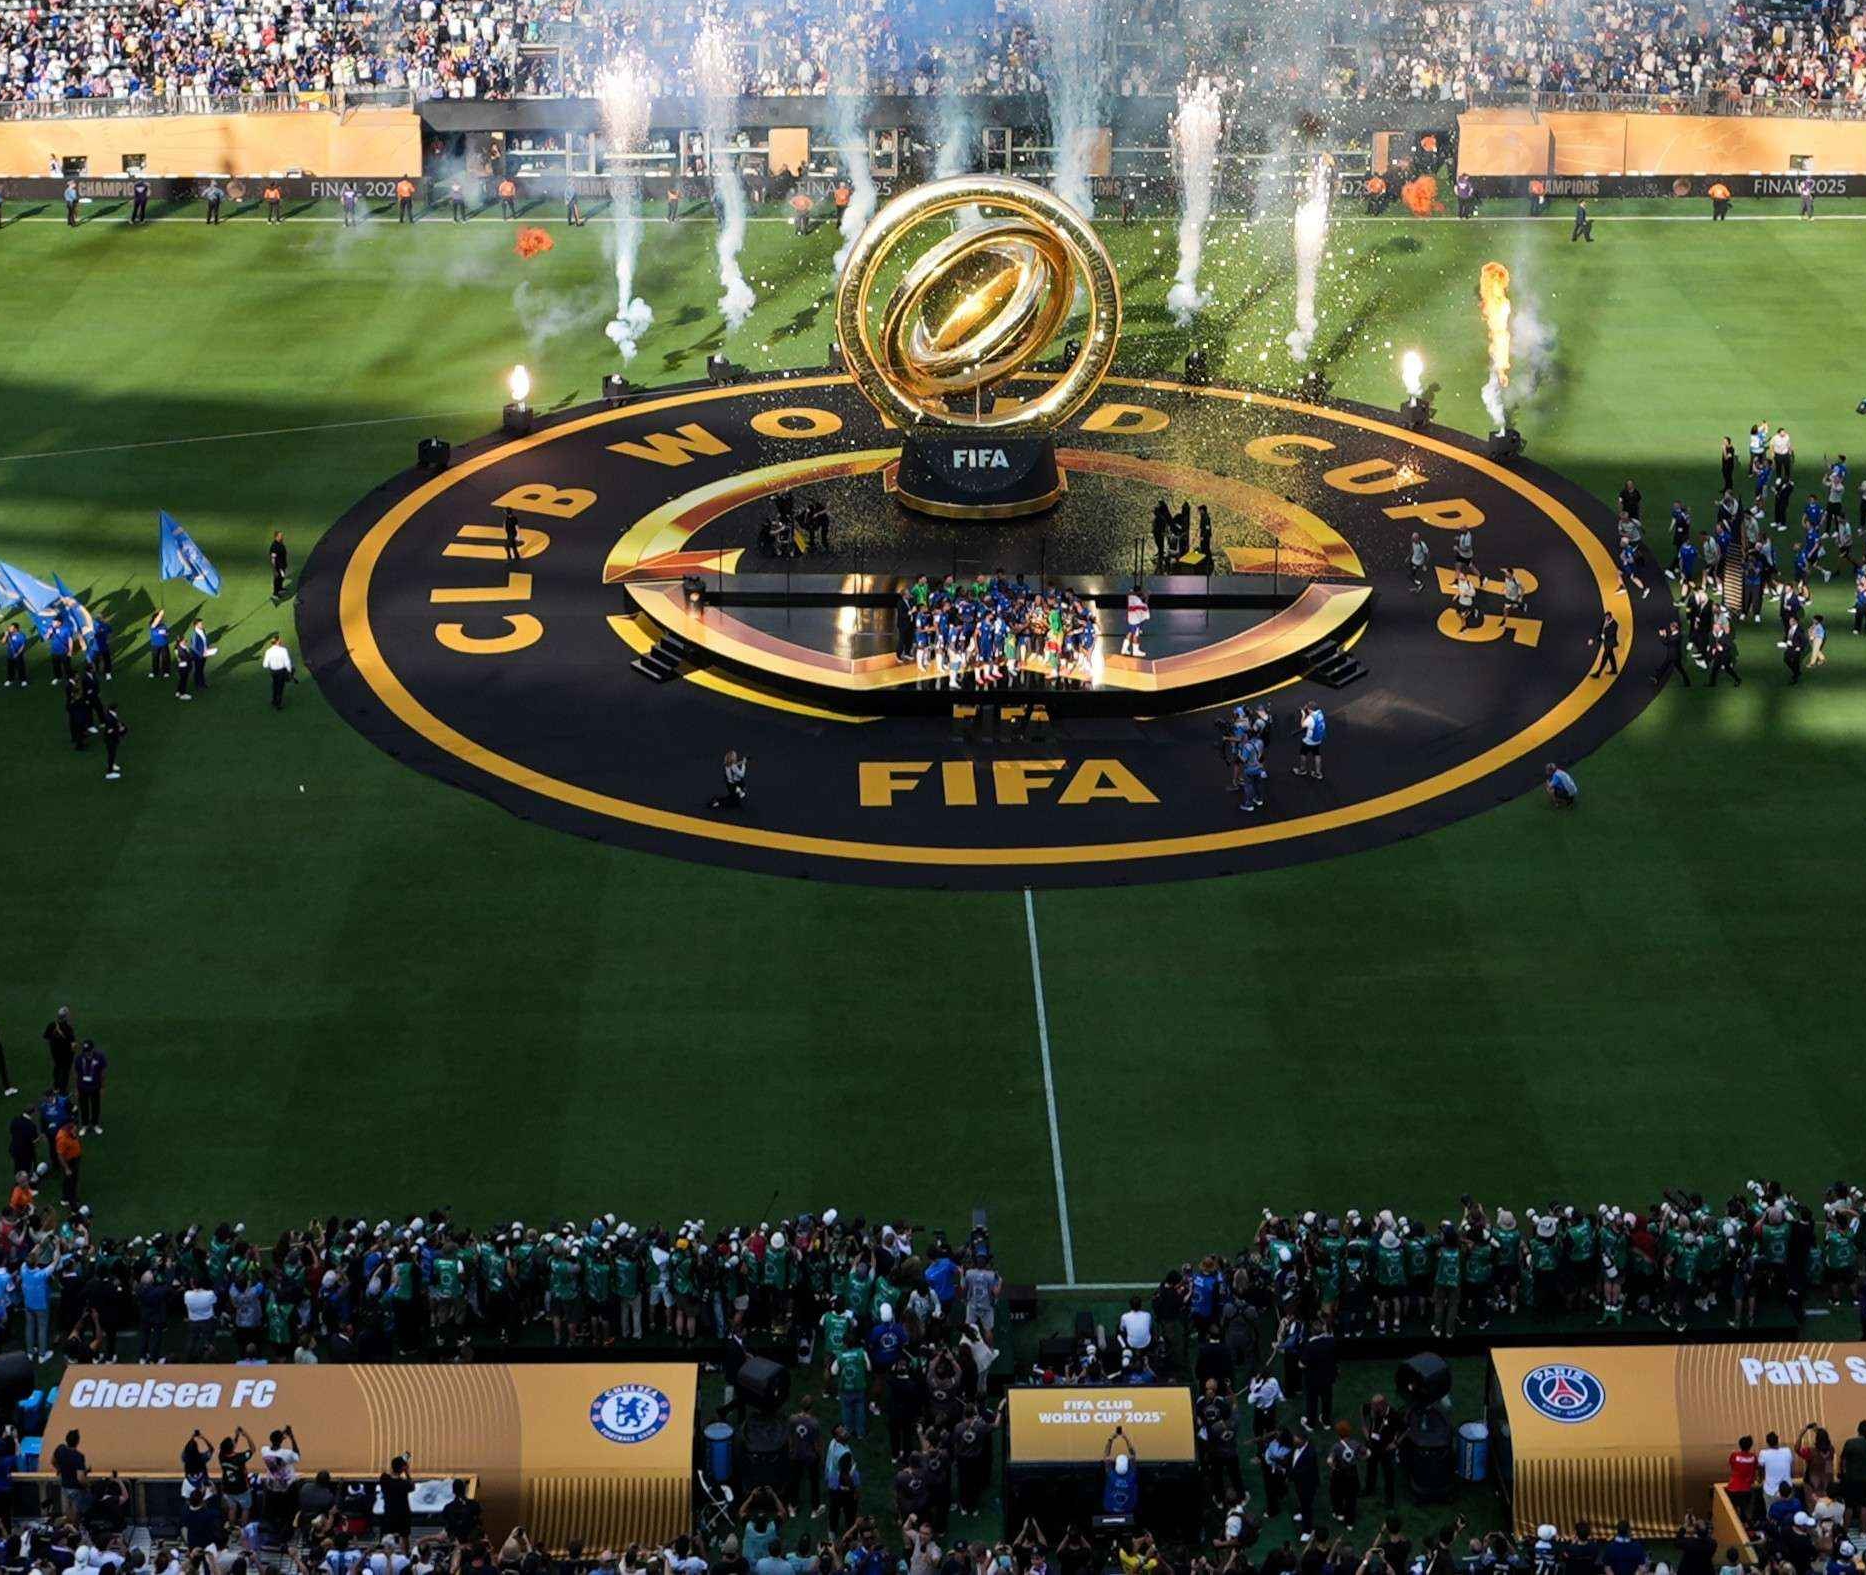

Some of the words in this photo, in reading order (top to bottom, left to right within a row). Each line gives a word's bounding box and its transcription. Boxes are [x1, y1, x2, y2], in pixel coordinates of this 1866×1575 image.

[77, 181, 147, 197] CHAMPIO
[365, 181, 396, 197] 202
[794, 181, 837, 197] FINA
[953, 448, 1010, 468] FIFA
[430, 482, 598, 655] CLUB
[606, 399, 1171, 467] WOD
[1244, 433, 1485, 530] CUP
[1435, 565, 1543, 648] 25
[858, 758, 1161, 807] FIFA
[1739, 1355, 1839, 1387] Paris
[70, 1378, 222, 1408] Chelsea
[231, 1379, 277, 1408] FC
[1063, 1400, 1094, 1410] FIFA
[1097, 1400, 1133, 1410] CLUB
[1039, 1412, 1091, 1424] WORLD
[1094, 1412, 1123, 1424] CUP
